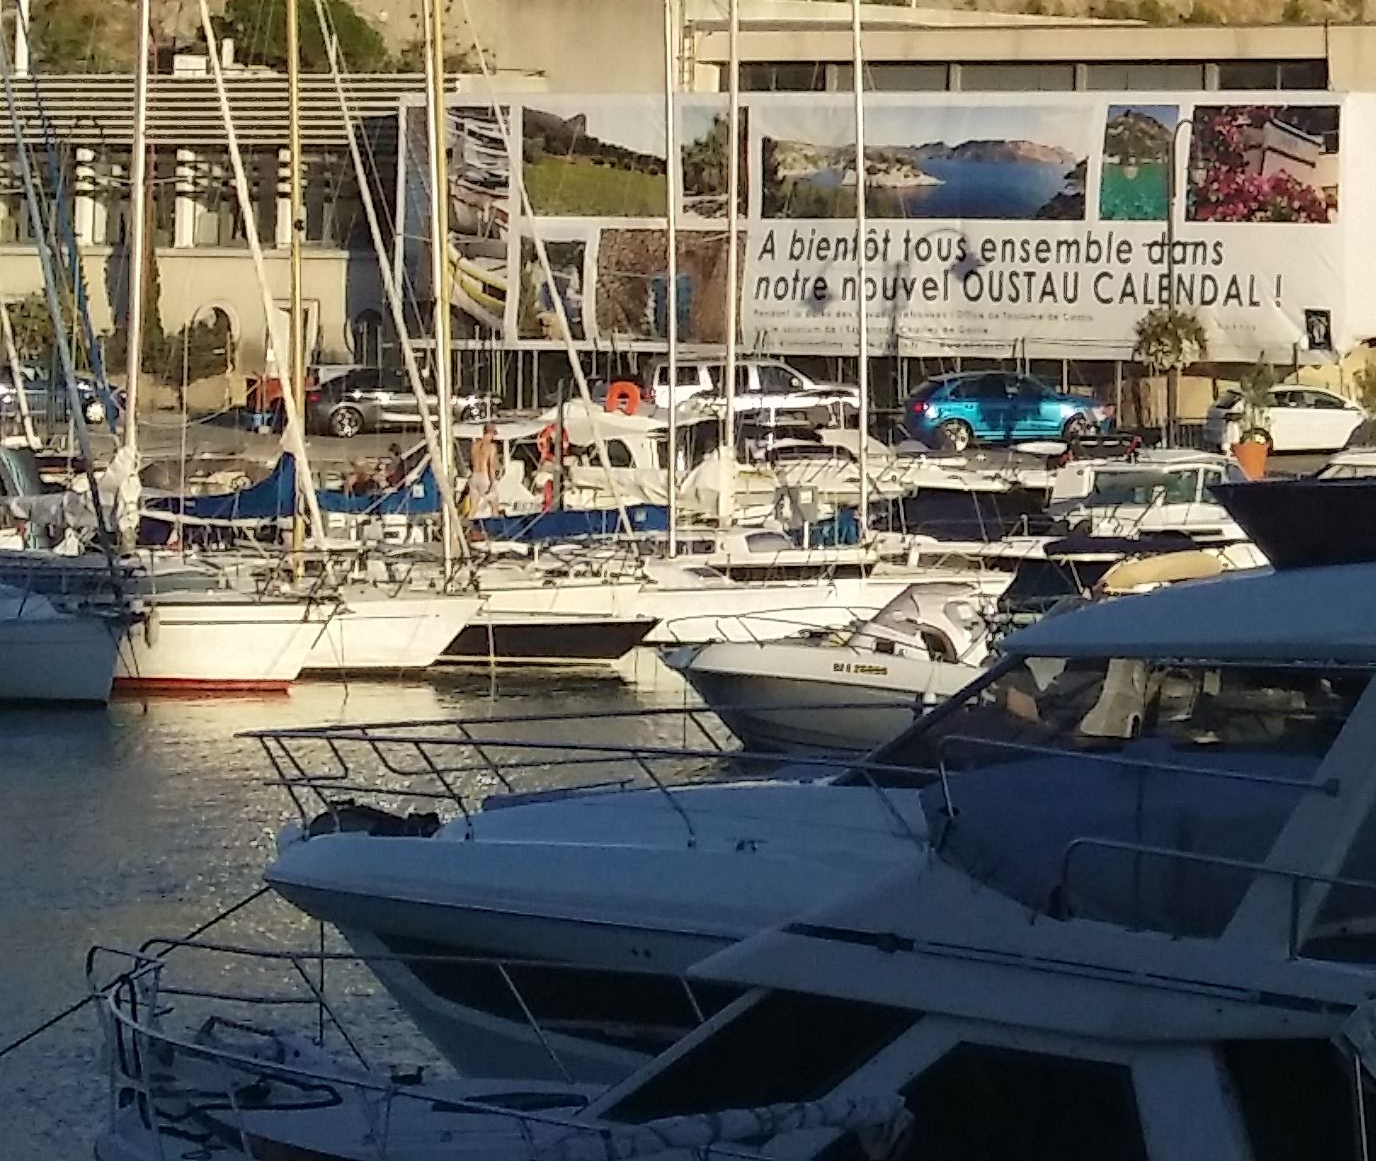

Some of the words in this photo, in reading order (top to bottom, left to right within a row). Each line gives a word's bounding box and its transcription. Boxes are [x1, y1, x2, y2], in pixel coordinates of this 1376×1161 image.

[757, 229, 775, 261] A
[788, 228, 891, 262] bientôt
[903, 229, 967, 262] tous
[980, 230, 1133, 264] ensemble
[1147, 231, 1224, 266] dans
[754, 269, 828, 301] notre
[841, 269, 949, 302] nouvel
[963, 270, 1079, 304] OUSTAU
[1093, 271, 1261, 307] CALENDAL
[1275, 274, 1284, 308] !
